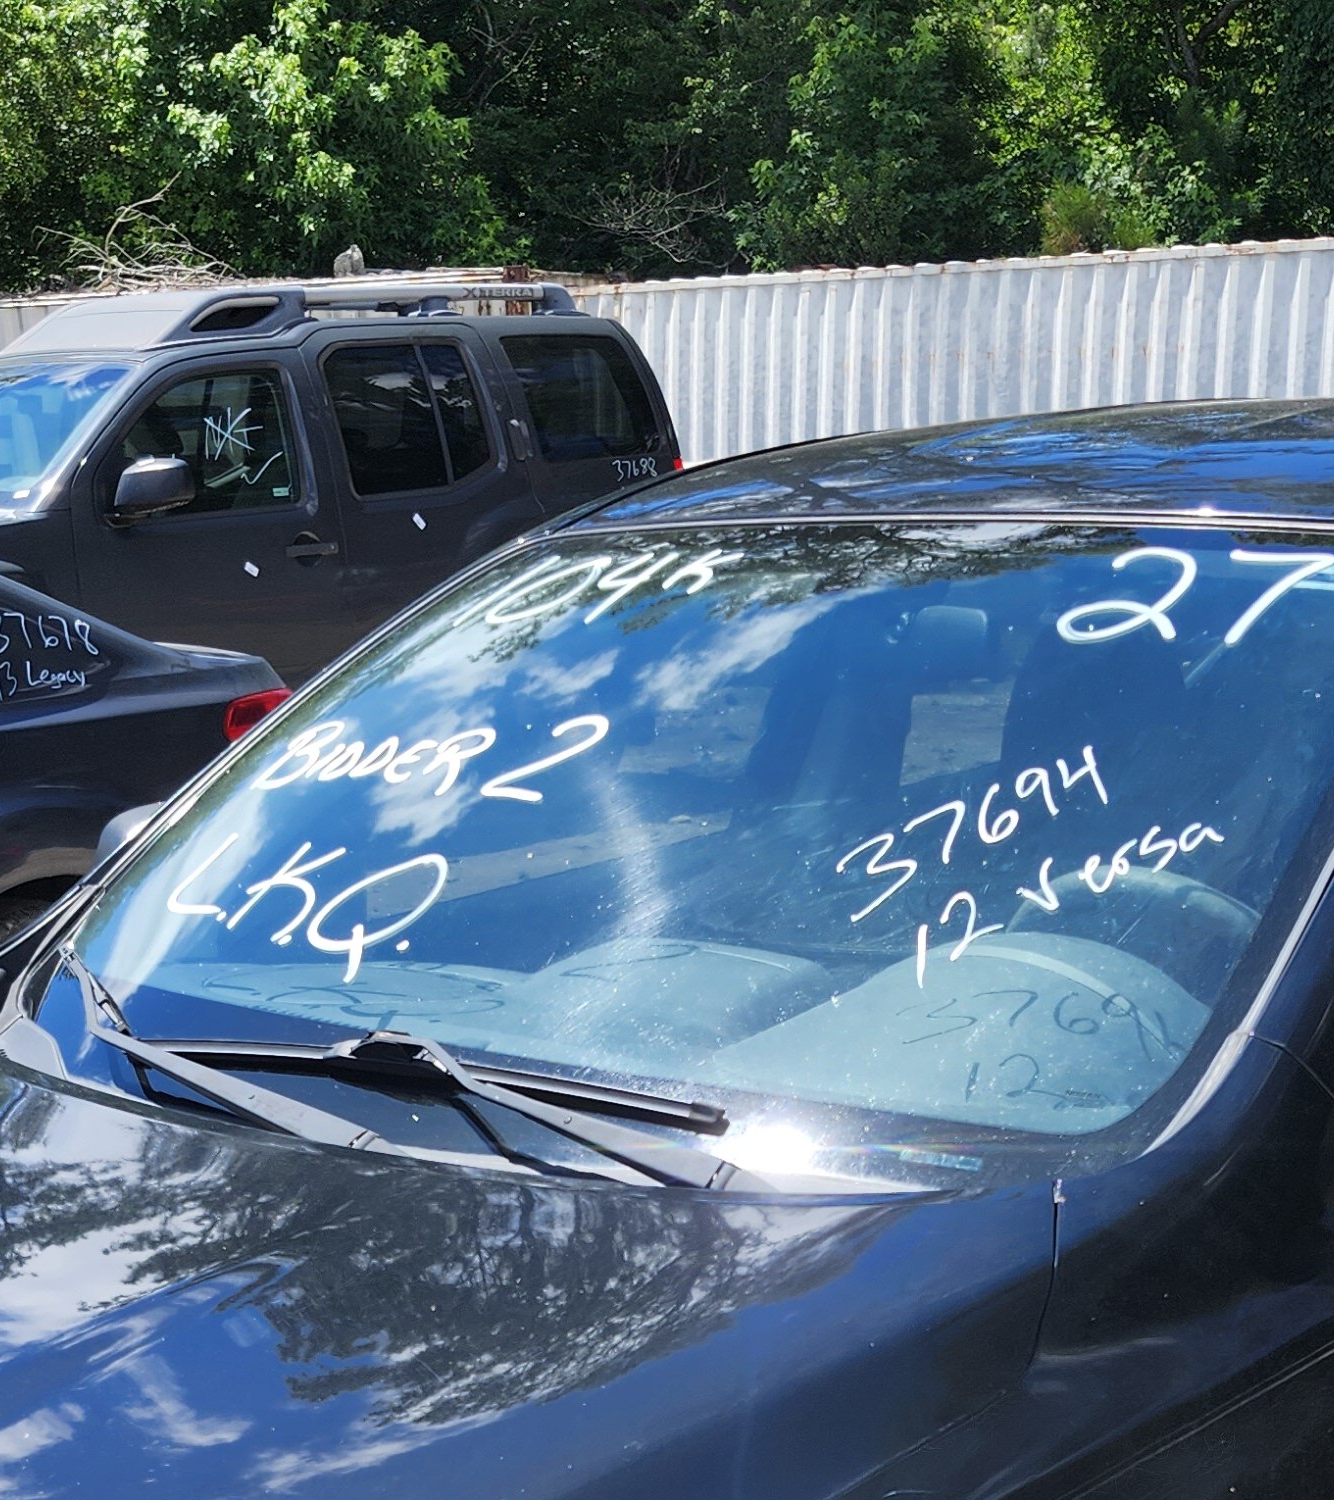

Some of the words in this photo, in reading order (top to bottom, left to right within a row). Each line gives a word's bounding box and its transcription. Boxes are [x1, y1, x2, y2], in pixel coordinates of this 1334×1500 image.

[462, 286, 533, 299] XTERRA
[611, 456, 658, 482] 37688
[26, 660, 86, 690] Legacy
[250, 720, 497, 797] BIDDER
[479, 714, 610, 803] 2
[835, 744, 1109, 924] 37694
[916, 890, 1005, 990] 12
